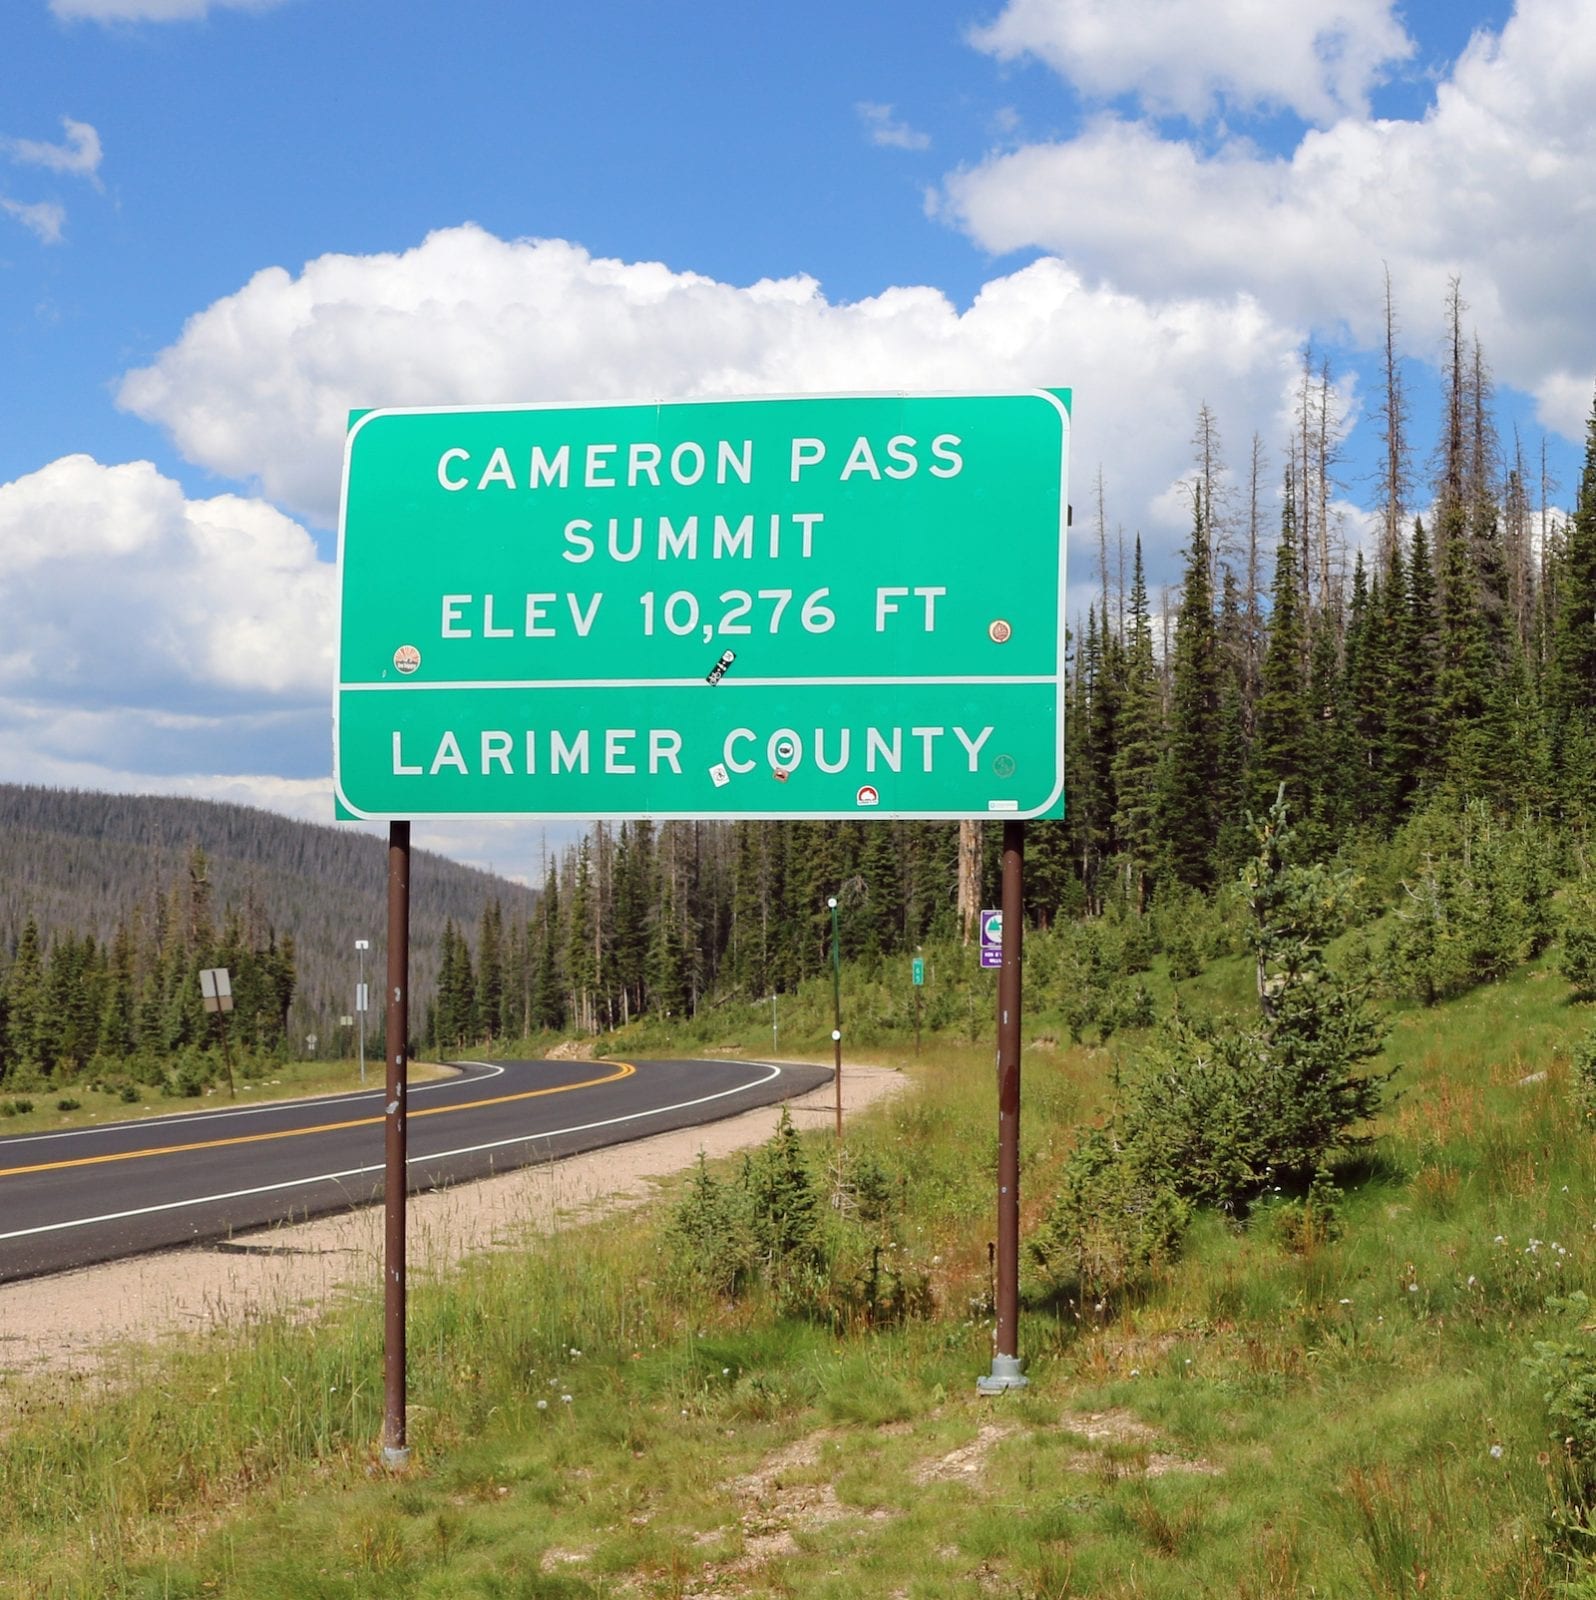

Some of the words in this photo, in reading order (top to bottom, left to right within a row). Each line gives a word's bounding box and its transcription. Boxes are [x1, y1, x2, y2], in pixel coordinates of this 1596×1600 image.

[437, 440, 753, 491] CAMERON
[790, 433, 963, 482] PASS
[562, 513, 824, 563] SUMMIT
[441, 592, 603, 639] ELEV
[640, 587, 836, 645] 10,276
[875, 586, 946, 634] FT
[392, 729, 682, 775] LARIMER
[723, 726, 994, 774] COUNTY
